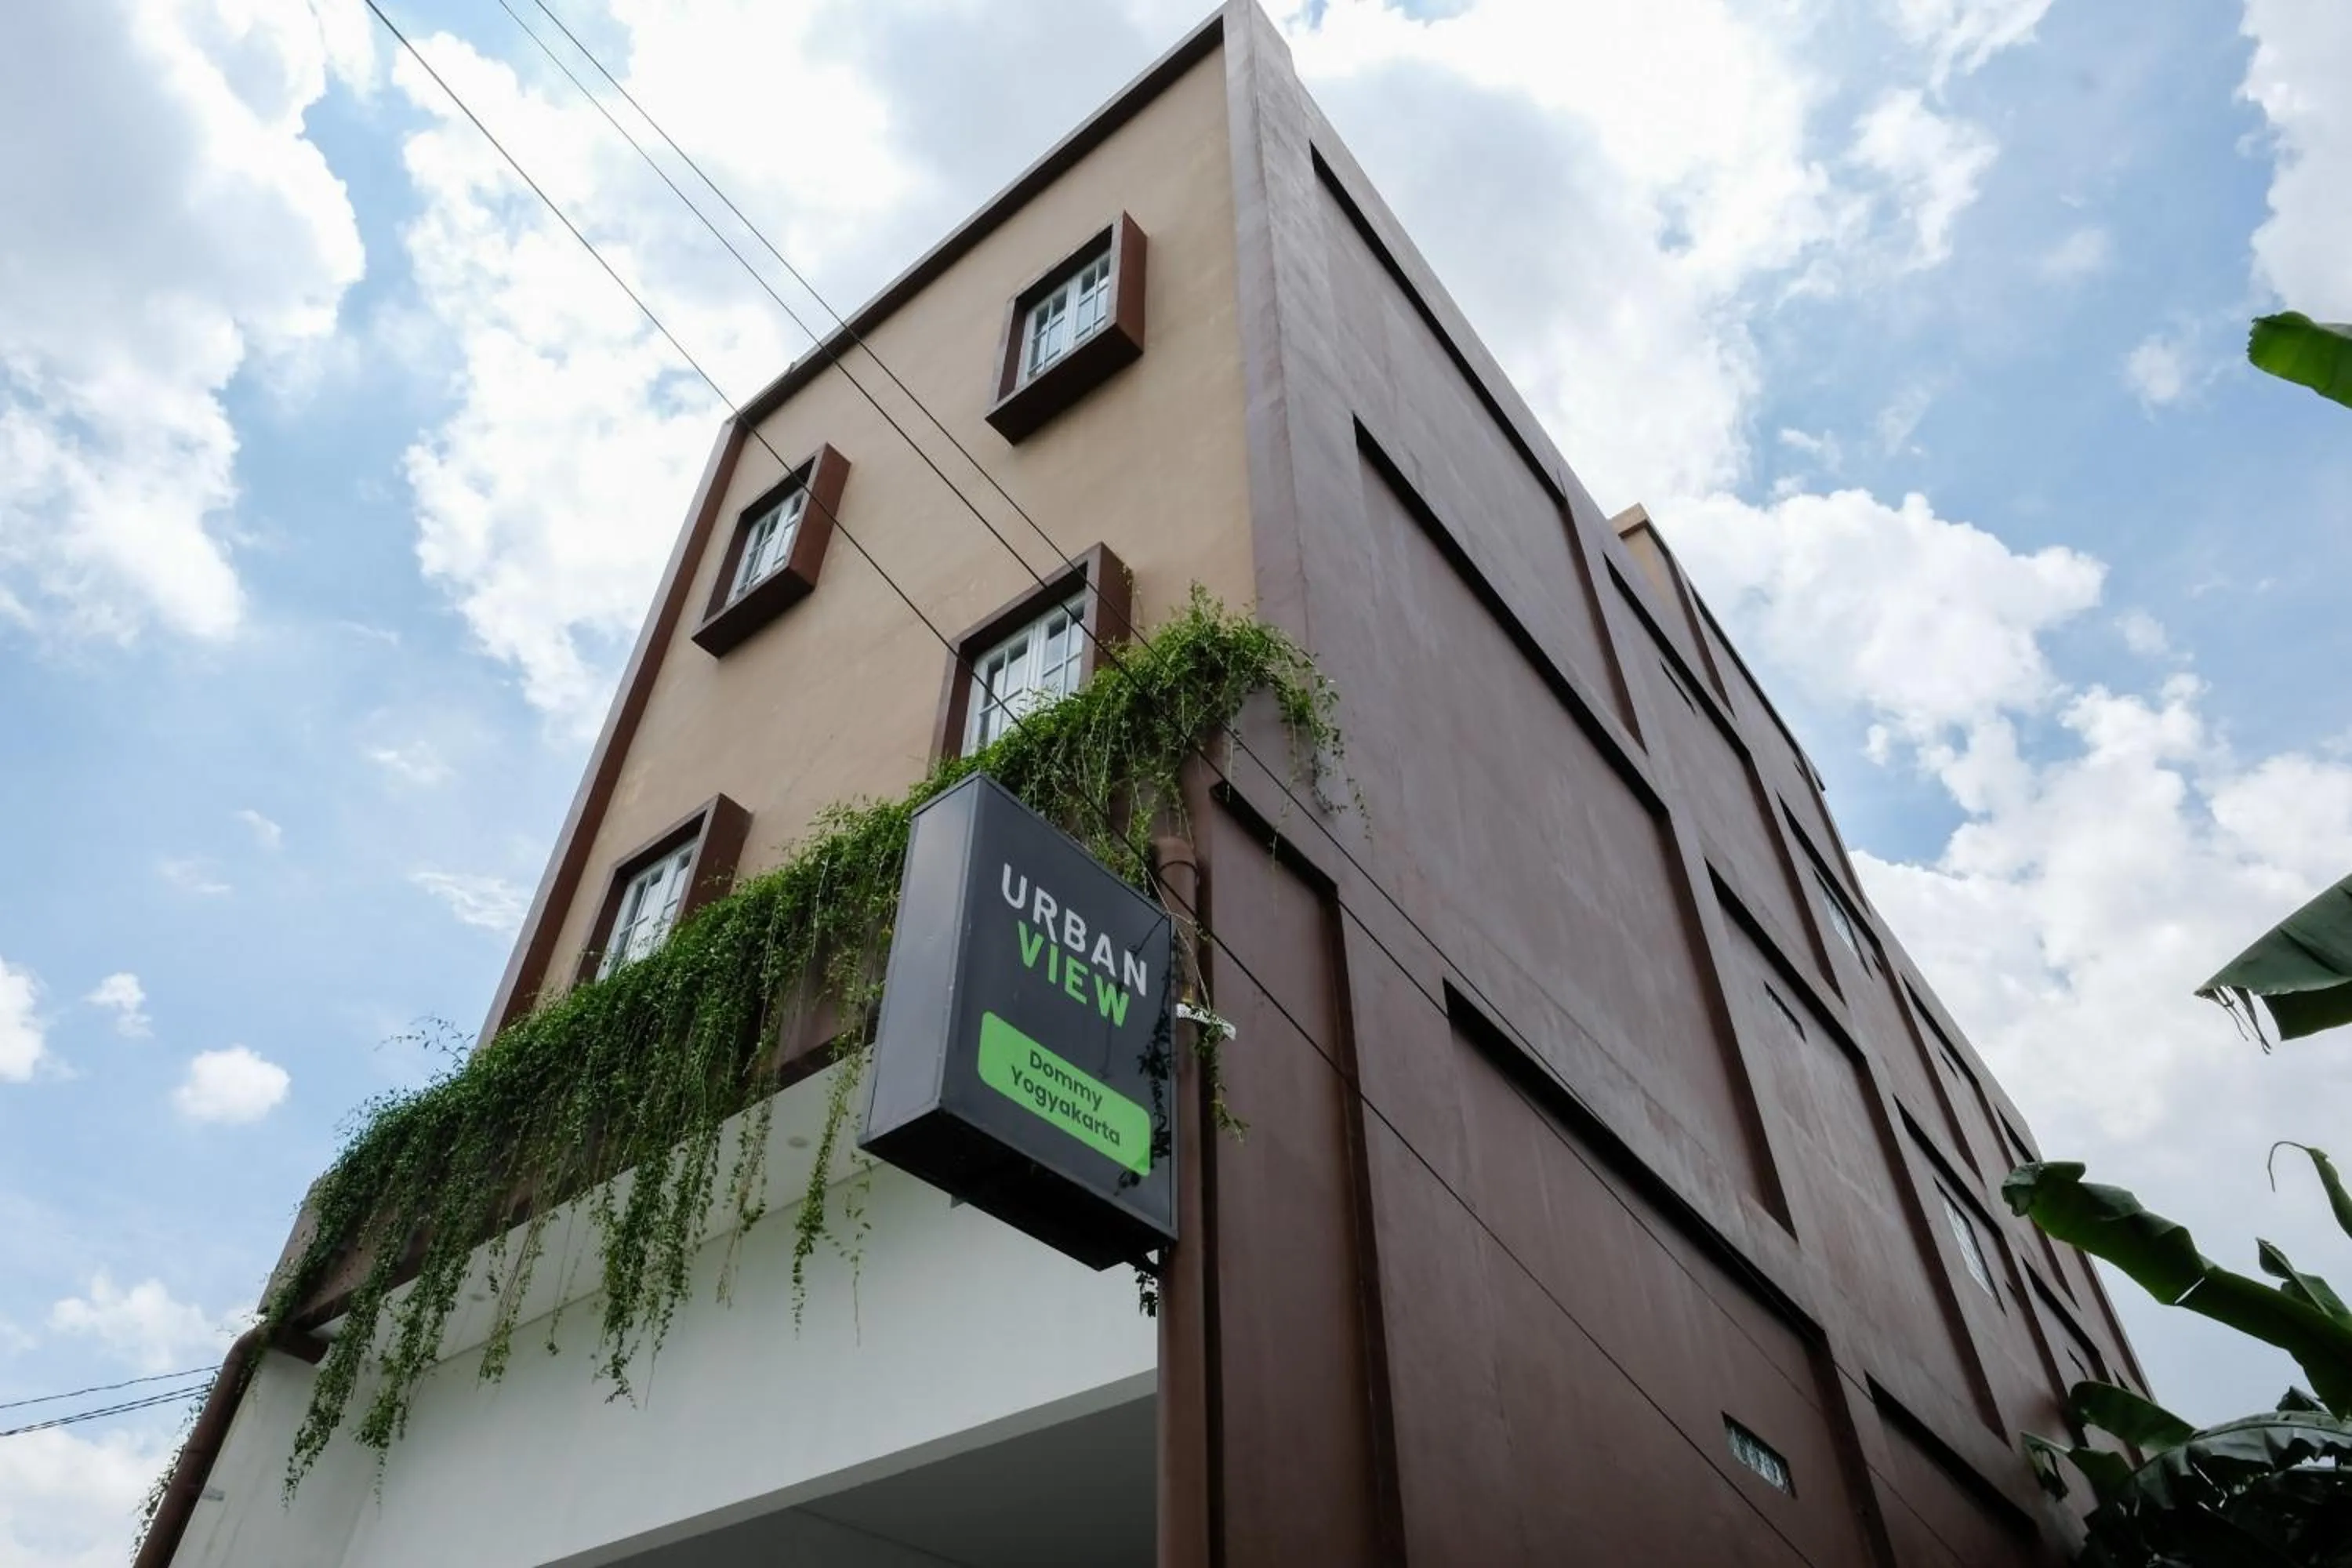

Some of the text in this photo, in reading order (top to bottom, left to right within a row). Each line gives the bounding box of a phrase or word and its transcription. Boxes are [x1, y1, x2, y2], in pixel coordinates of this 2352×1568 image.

[1002, 862, 1147, 996] URBAN
[1018, 920, 1129, 1027] VIEW
[1010, 1066, 1120, 1146] Yogyakarta
[1029, 1049, 1103, 1112] Dommy
